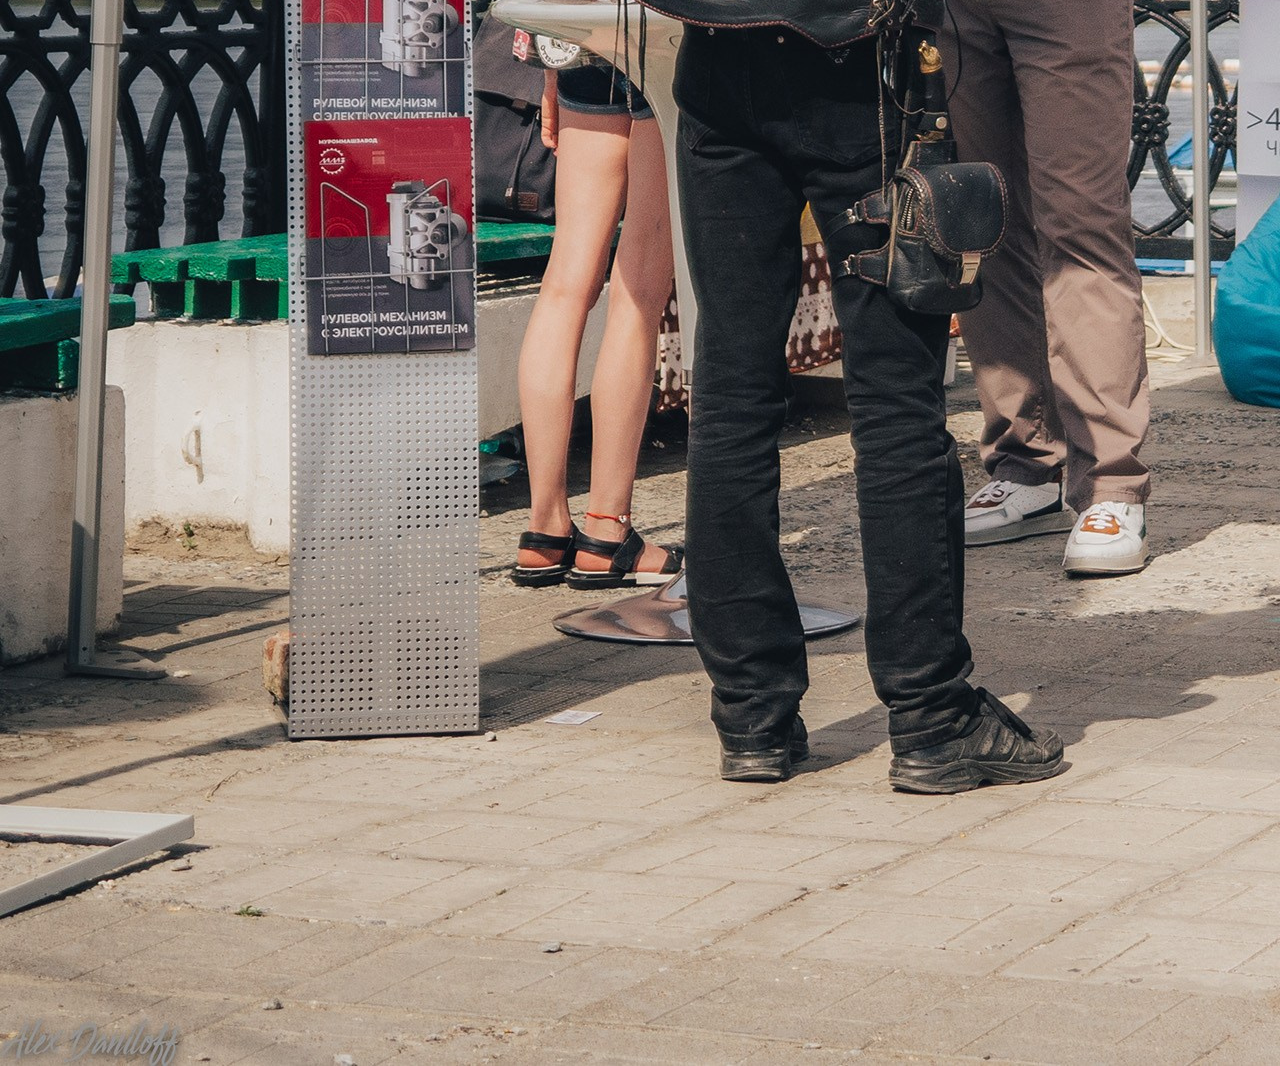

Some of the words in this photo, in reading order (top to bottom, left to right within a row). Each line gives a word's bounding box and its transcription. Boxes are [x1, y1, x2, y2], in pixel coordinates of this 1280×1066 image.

[313, 97, 367, 108] РУЛЕВОЙ
[371, 98, 437, 108] МЕХАНИЗМ
[322, 312, 377, 324] РУЛЕВОЙ
[380, 311, 446, 322] МЕХАНИЗМ
